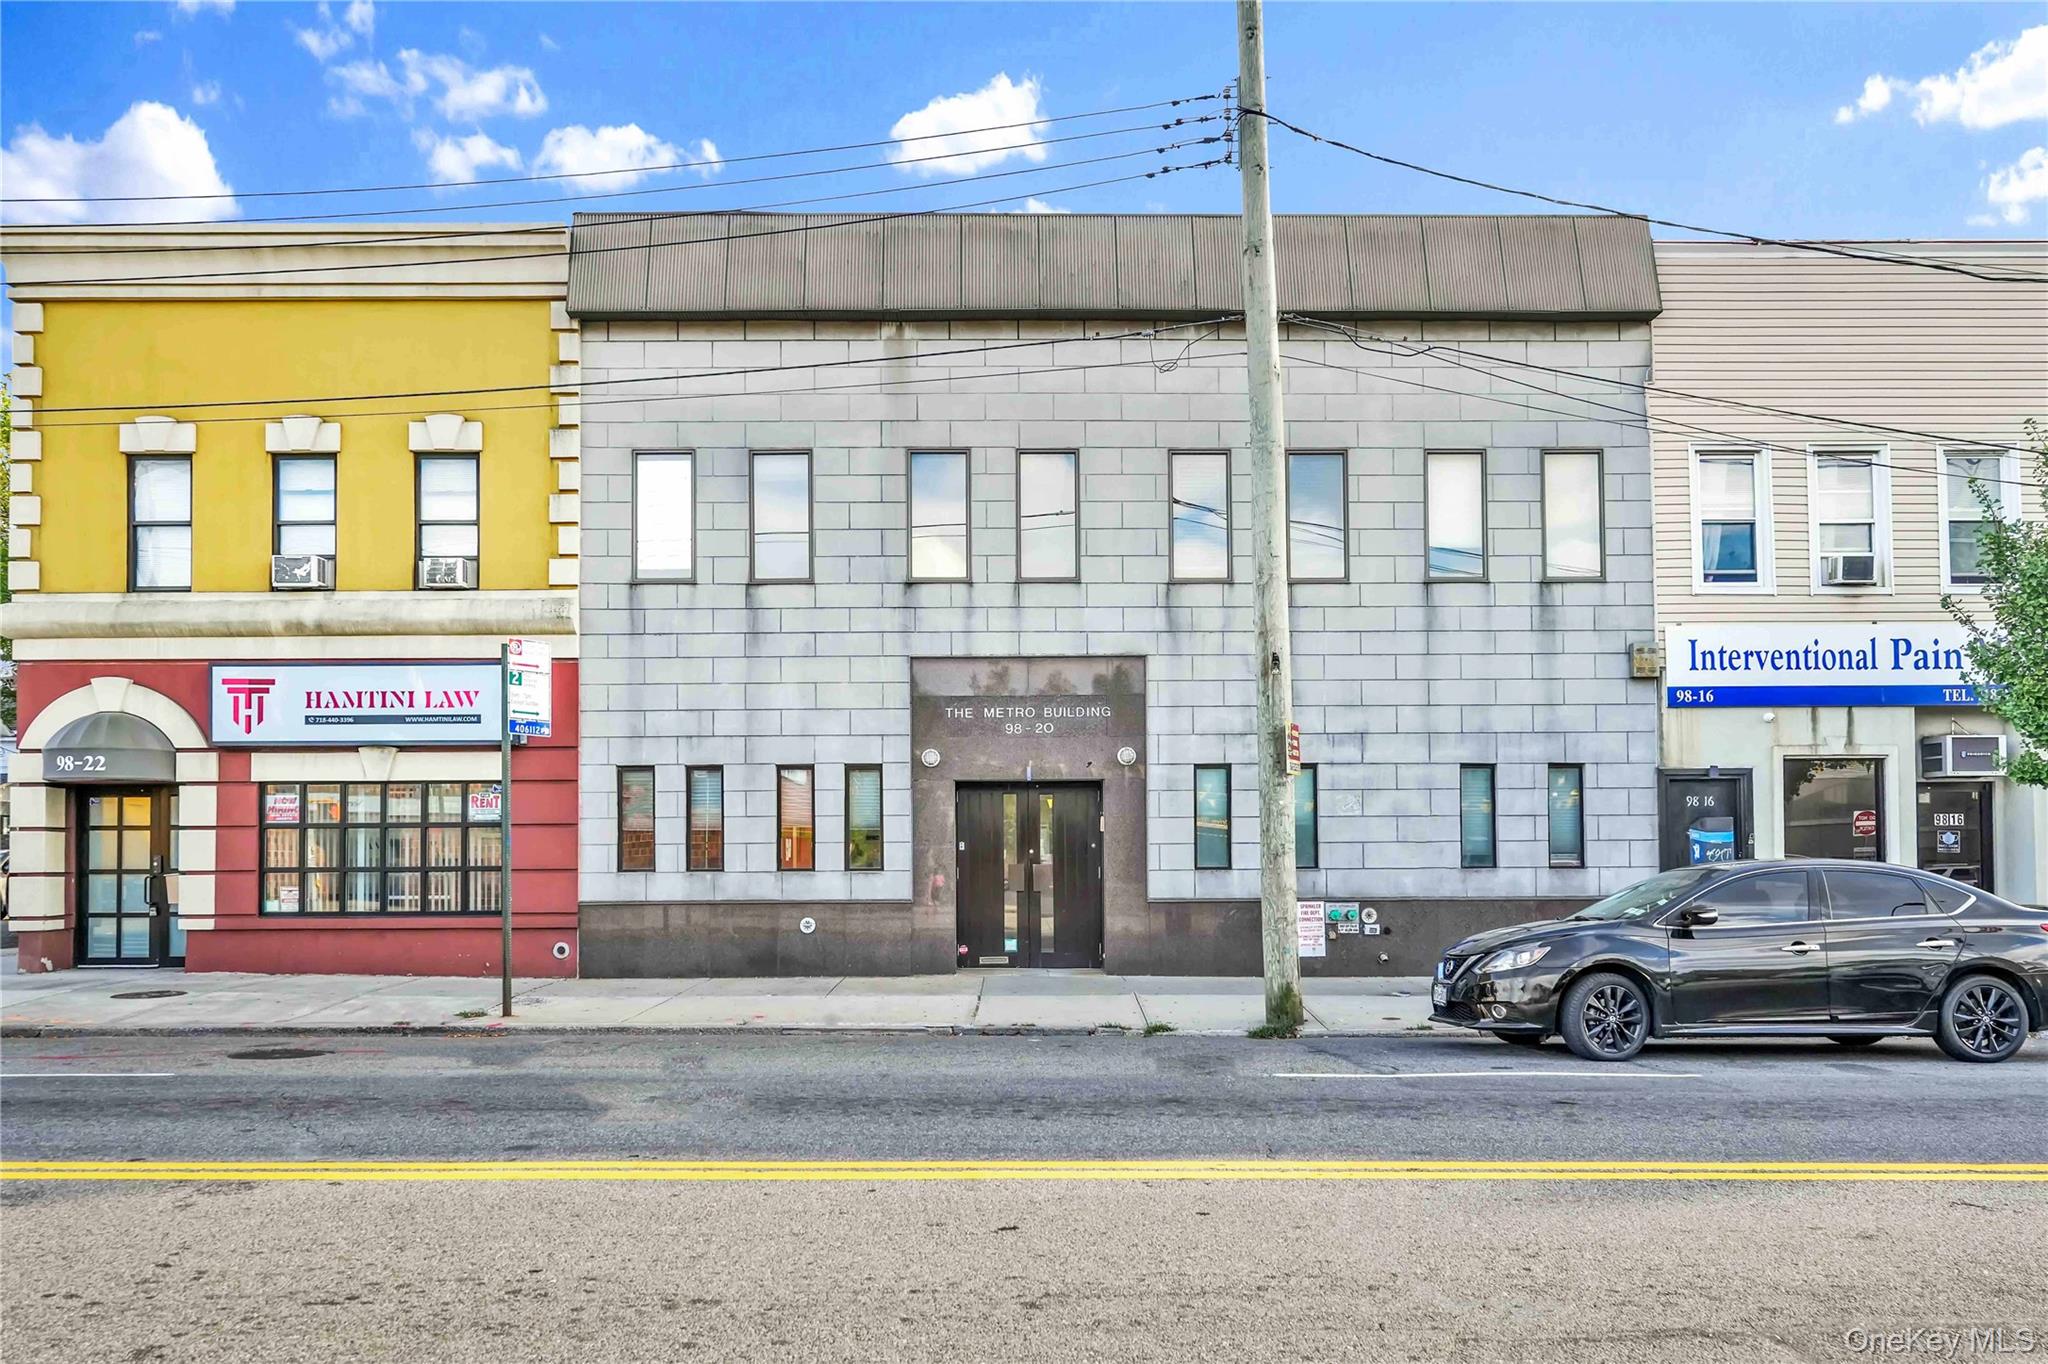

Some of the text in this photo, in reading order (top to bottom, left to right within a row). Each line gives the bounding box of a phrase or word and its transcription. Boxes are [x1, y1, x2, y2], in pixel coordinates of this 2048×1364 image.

[1688, 637, 1964, 671] Interventional Pain
[511, 671, 520, 685] 2
[305, 690, 480, 709] HAMTINI LAW
[1676, 689, 1714, 703] 98-16
[1943, 688, 1974, 702] TEL.
[945, 706, 1111, 719] THE METRO BUILDING
[56, 755, 107, 771] 98-22
[471, 795, 500, 809] RENT
[1686, 795, 1715, 807] 98 16
